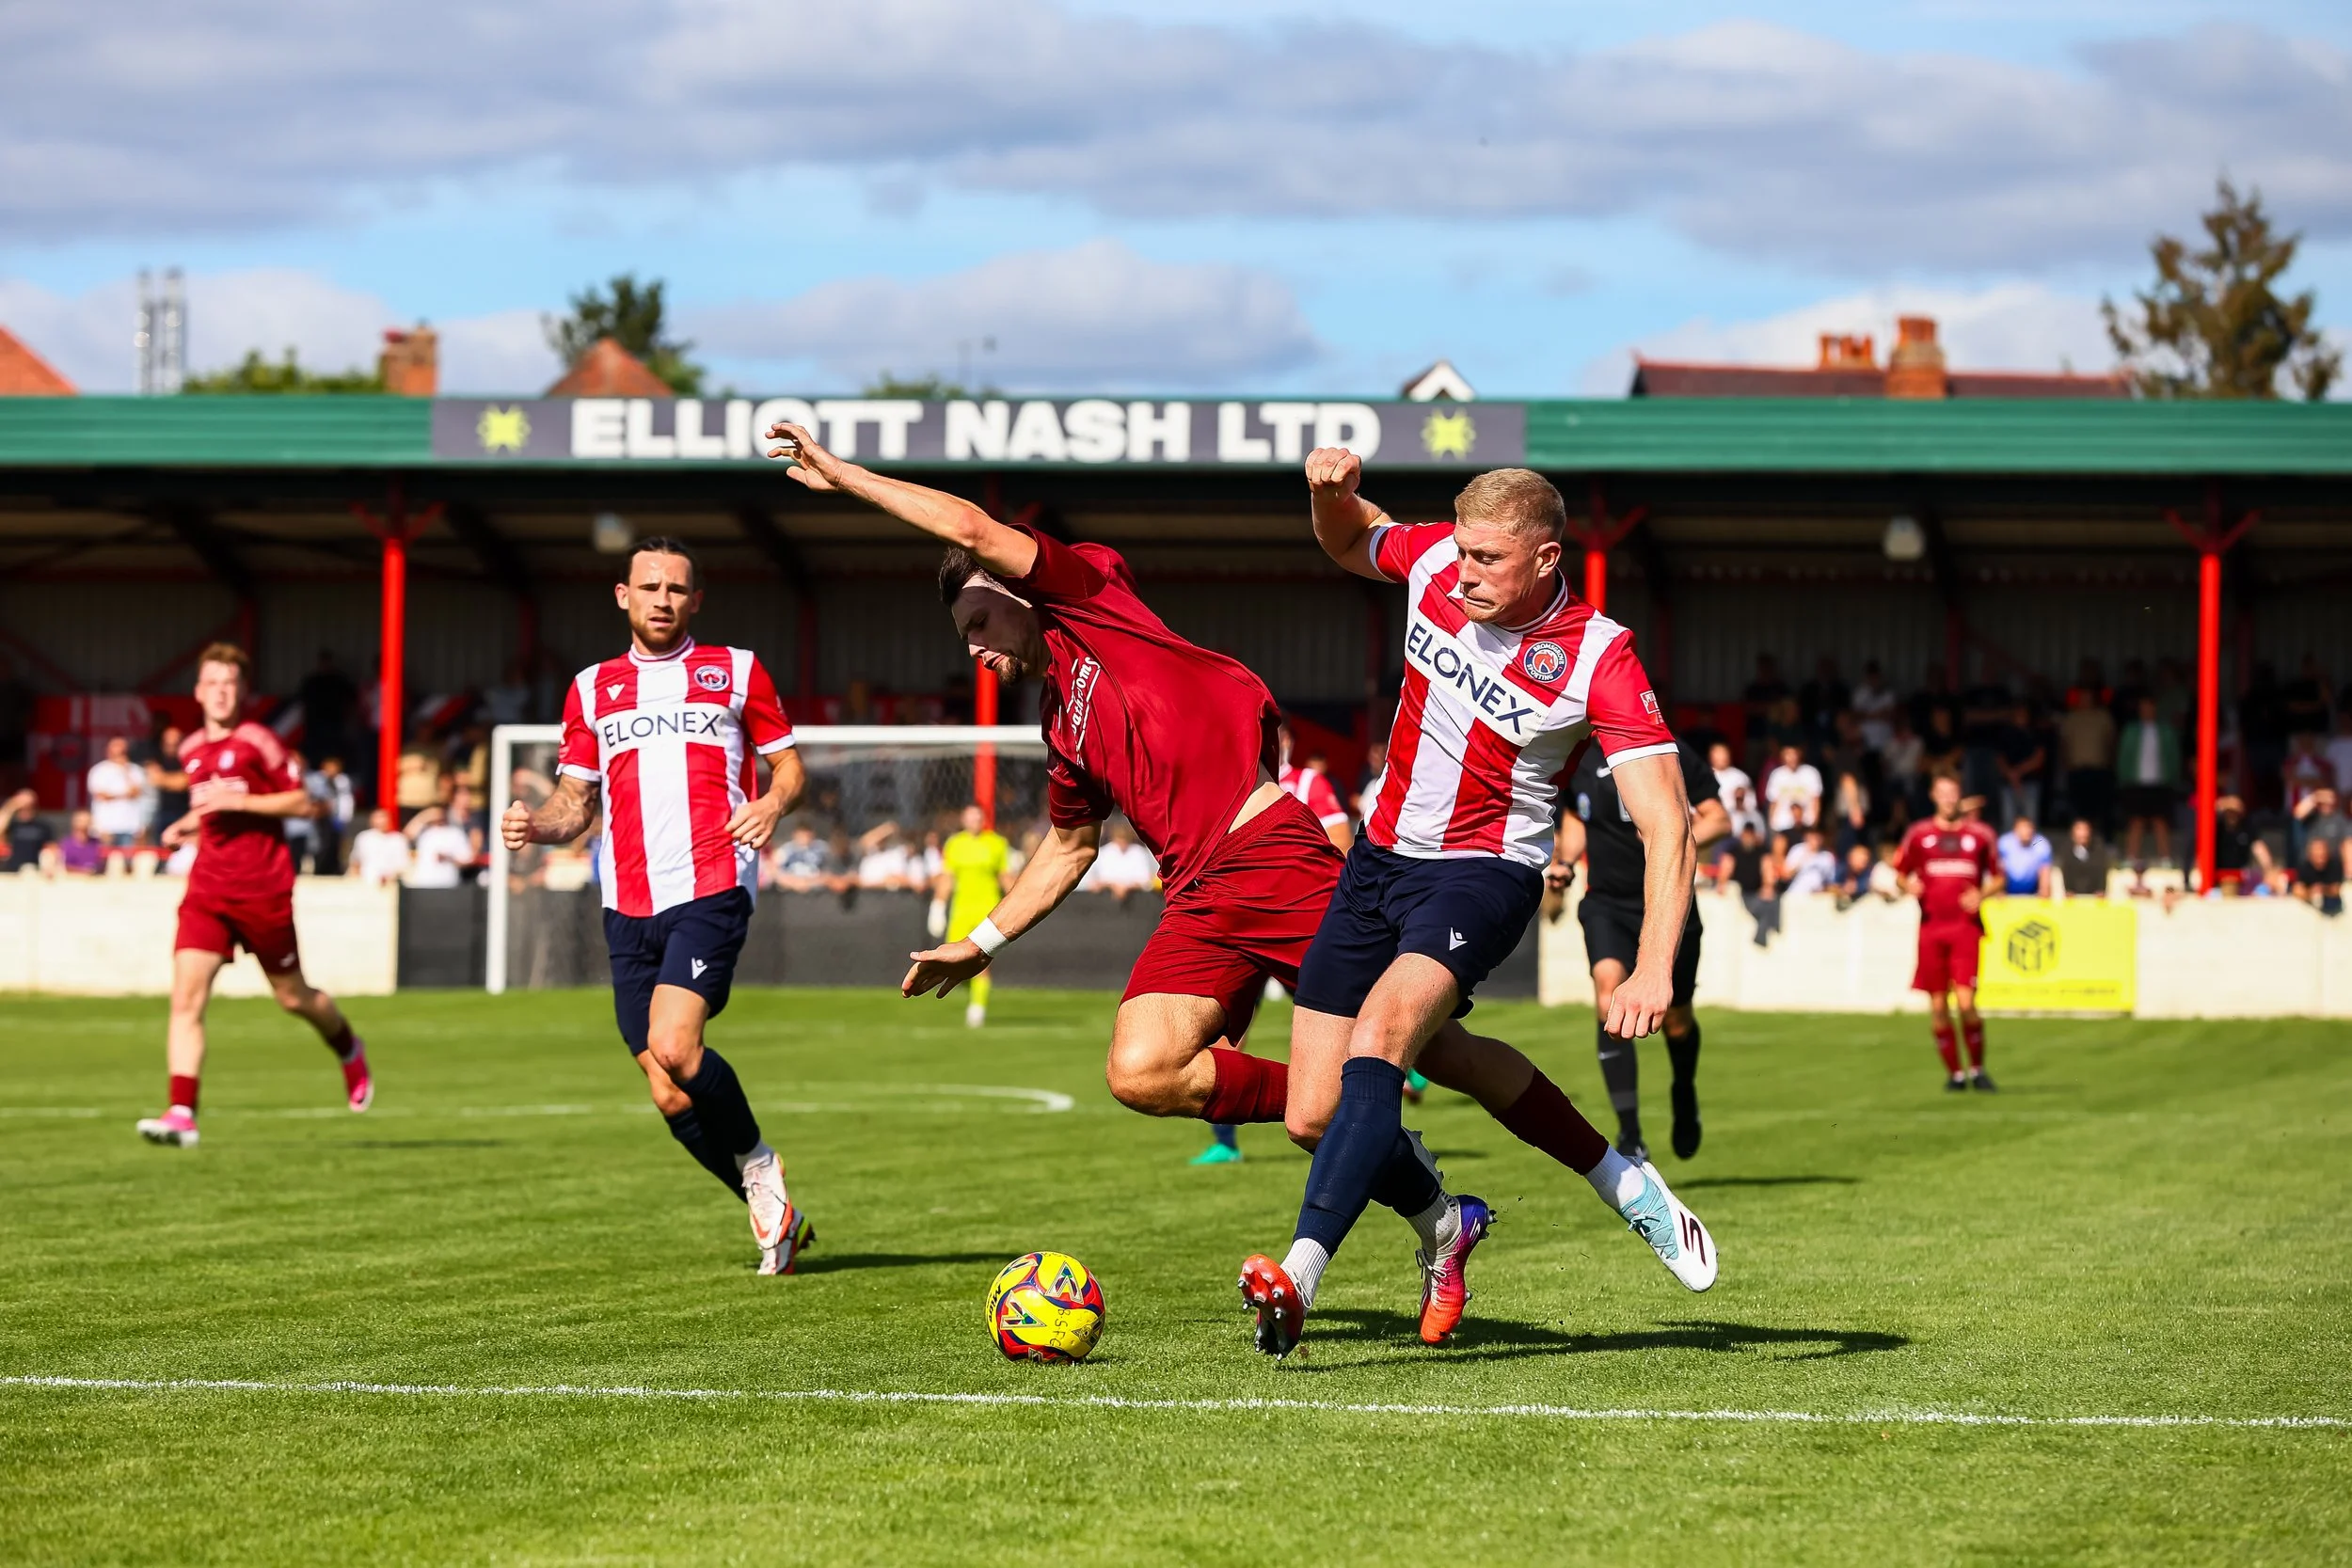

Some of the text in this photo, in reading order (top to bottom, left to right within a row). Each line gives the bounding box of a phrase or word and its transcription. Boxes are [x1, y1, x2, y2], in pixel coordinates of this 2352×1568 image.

[570, 398, 1381, 463] ELLIOTT NASH LTD
[1407, 622, 1534, 736] ELONEX
[1526, 663, 1554, 681] SPORTING
[604, 711, 721, 748] ELONEX
